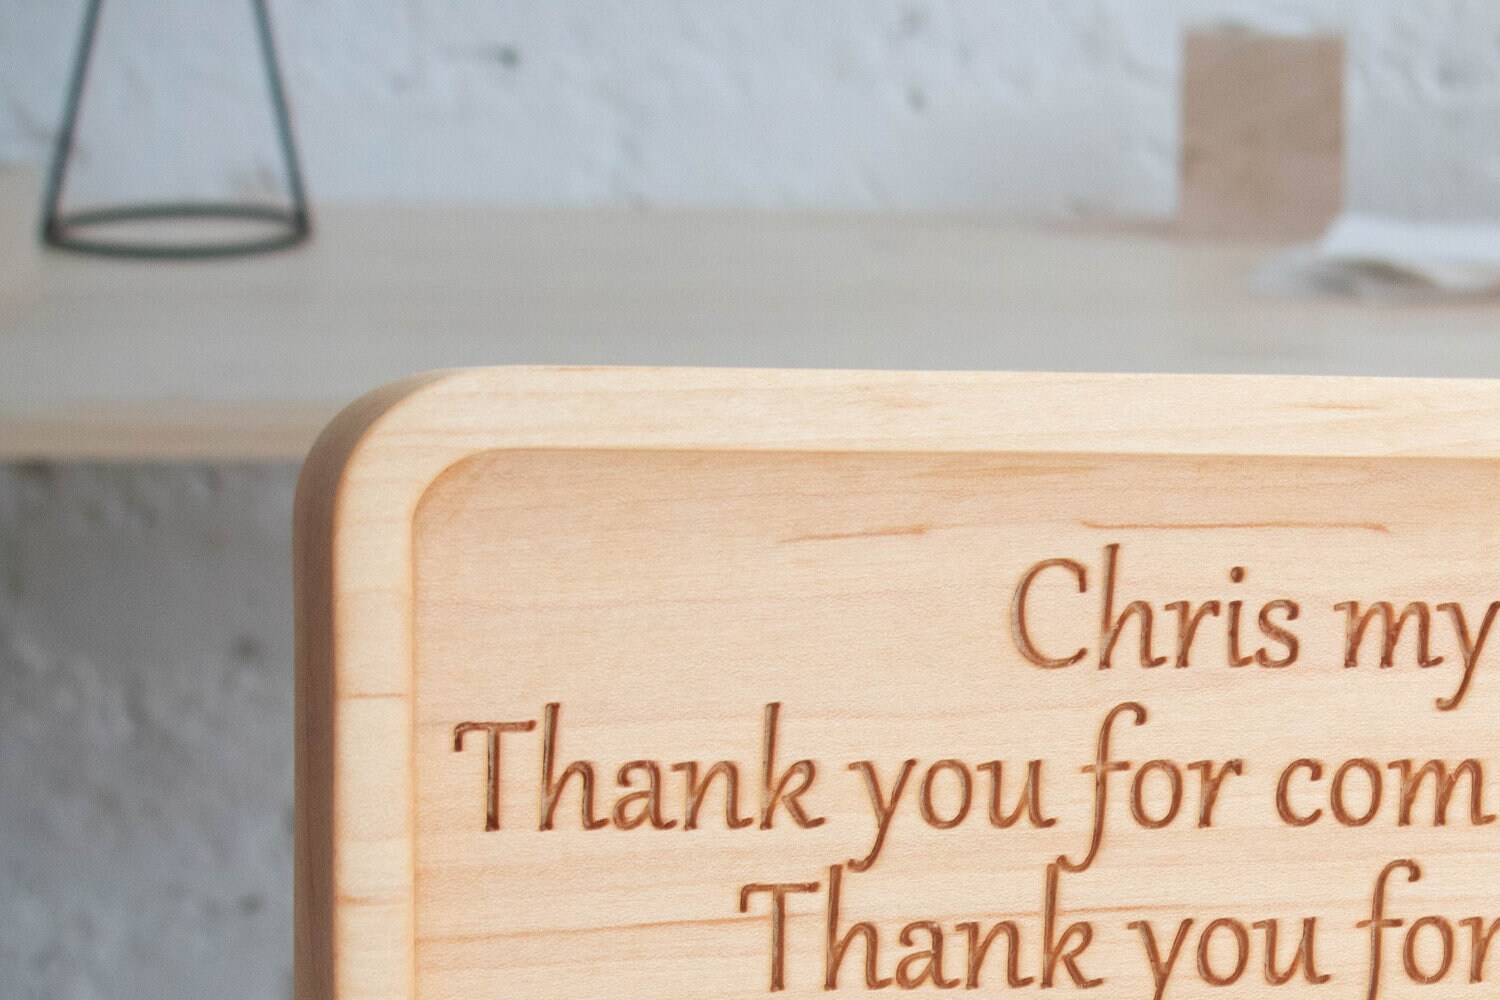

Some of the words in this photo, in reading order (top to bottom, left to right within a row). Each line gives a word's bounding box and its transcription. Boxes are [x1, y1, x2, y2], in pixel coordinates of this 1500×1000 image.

[1011, 543, 1301, 670] Chris
[453, 702, 825, 832] Thank
[848, 758, 1056, 870] you
[1056, 702, 1244, 873] for
[739, 863, 1103, 992] Thank
